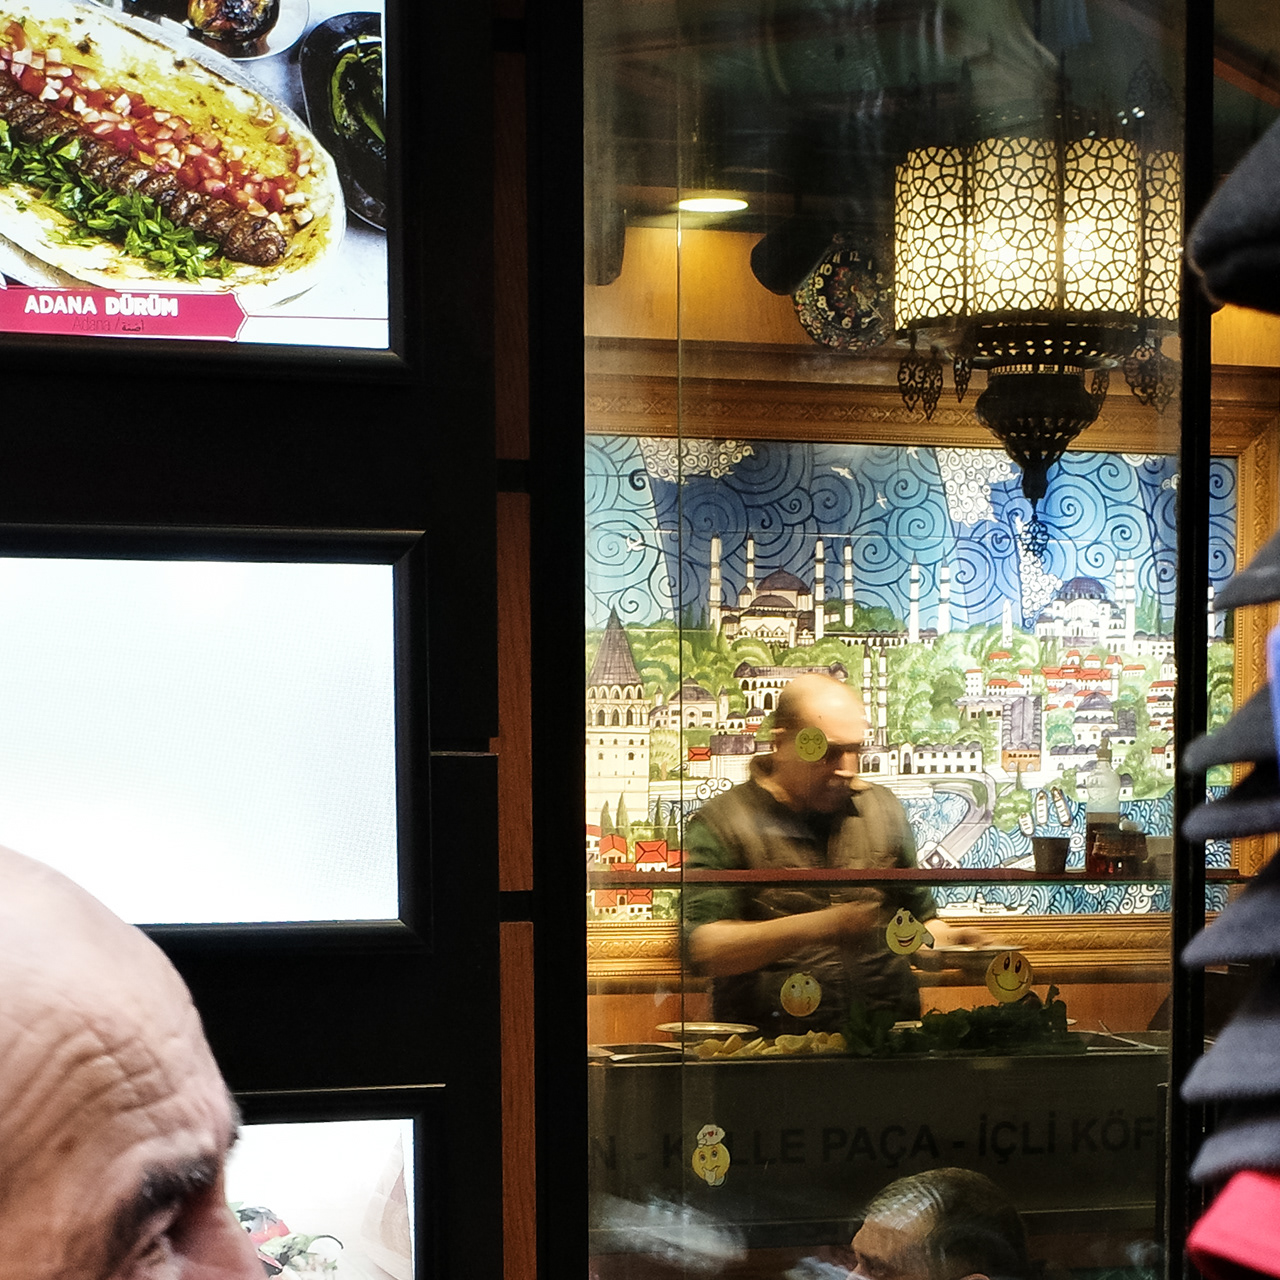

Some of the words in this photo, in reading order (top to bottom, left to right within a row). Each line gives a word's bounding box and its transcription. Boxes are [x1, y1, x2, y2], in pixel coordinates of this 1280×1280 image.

[24, 294, 98, 315] ADANA
[105, 294, 179, 317] DÜRÜM
[72, 317, 111, 332] Adana
[662, 1127, 806, 1169] KLLE
[822, 1122, 939, 1169] PAÇA
[977, 1111, 1058, 1166] İÇLİ
[1071, 1109, 1155, 1153] KÖF
